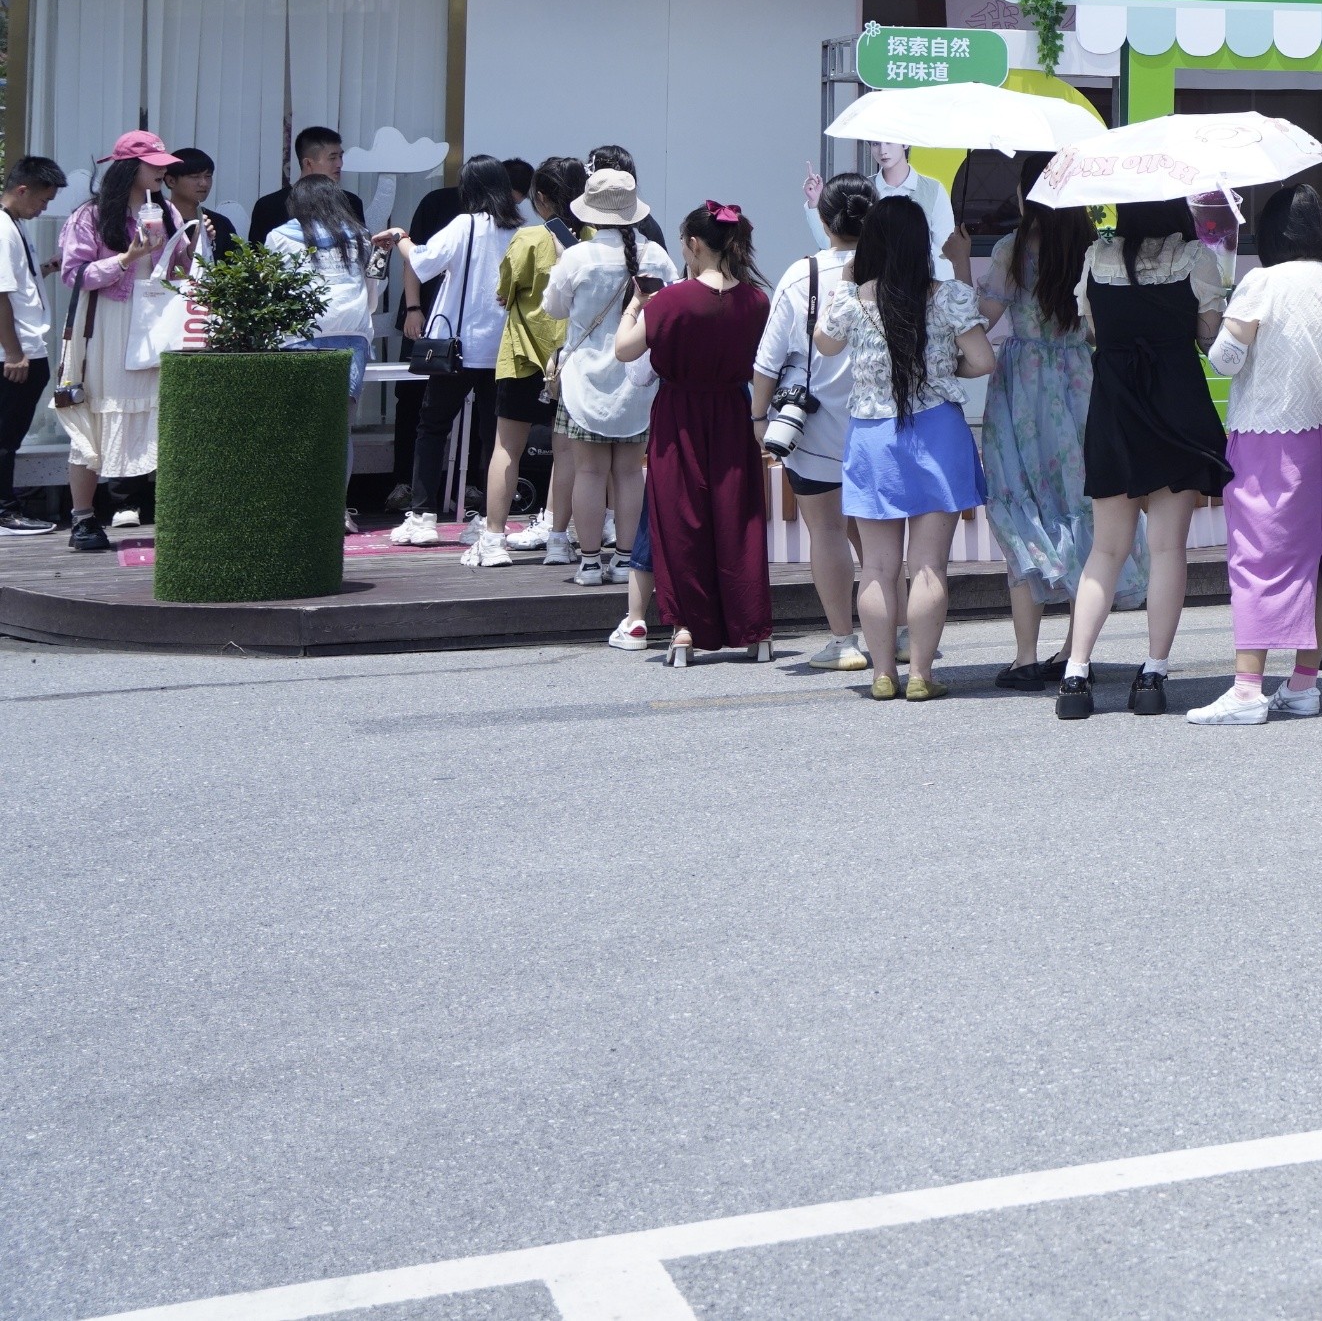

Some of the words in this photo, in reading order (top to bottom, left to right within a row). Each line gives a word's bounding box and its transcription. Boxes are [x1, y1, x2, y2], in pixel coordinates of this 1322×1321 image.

[887, 36, 970, 58] 探索自然
[886, 61, 949, 82] 好味道
[1122, 154, 1200, 185] Hello
[809, 295, 818, 315] Canon
